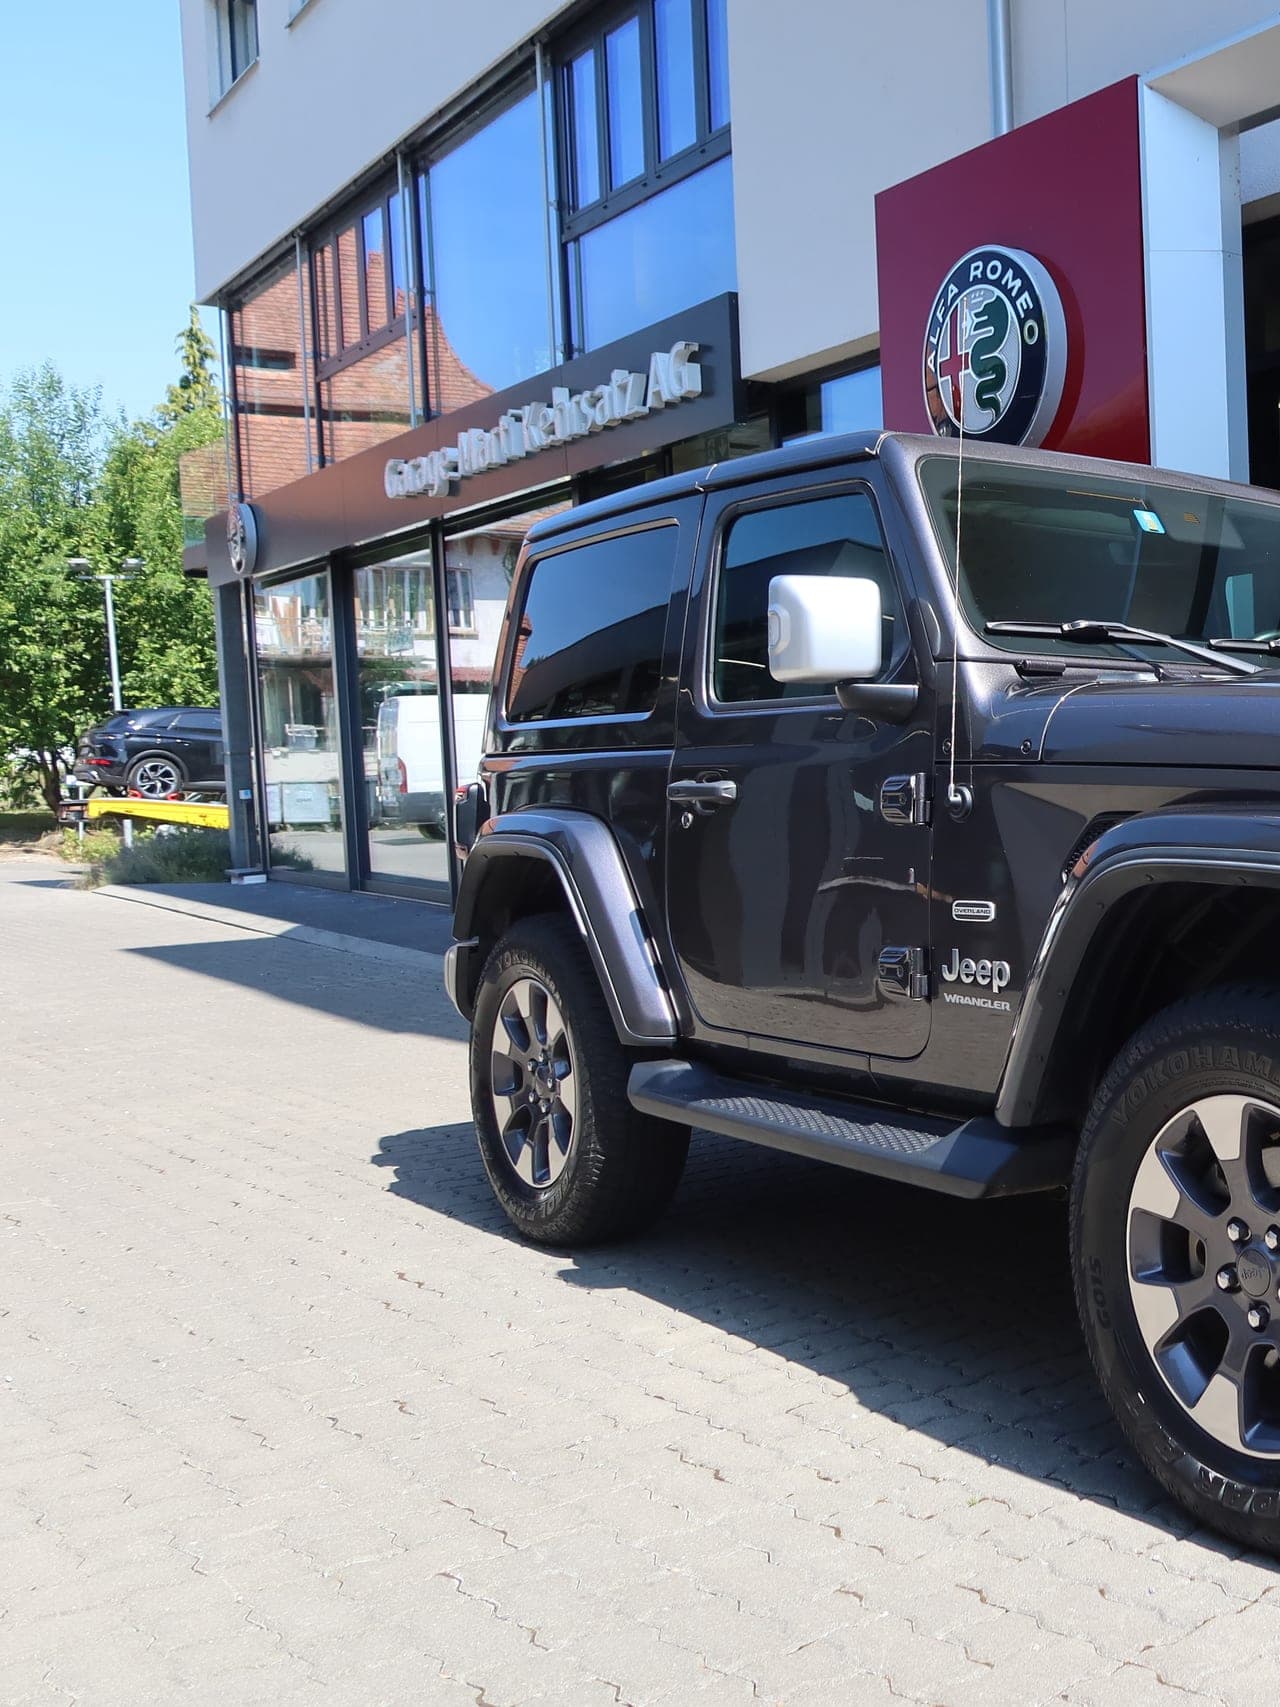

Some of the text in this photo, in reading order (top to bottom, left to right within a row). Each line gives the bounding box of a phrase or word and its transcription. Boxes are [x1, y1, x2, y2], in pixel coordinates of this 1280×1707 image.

[927, 260, 1039, 372] ALFA ROMEO
[522, 369, 648, 452] Kehrsatz
[647, 341, 702, 408] AG
[942, 948, 1011, 994] Jeep
[943, 992, 1011, 1011] WRANGLER
